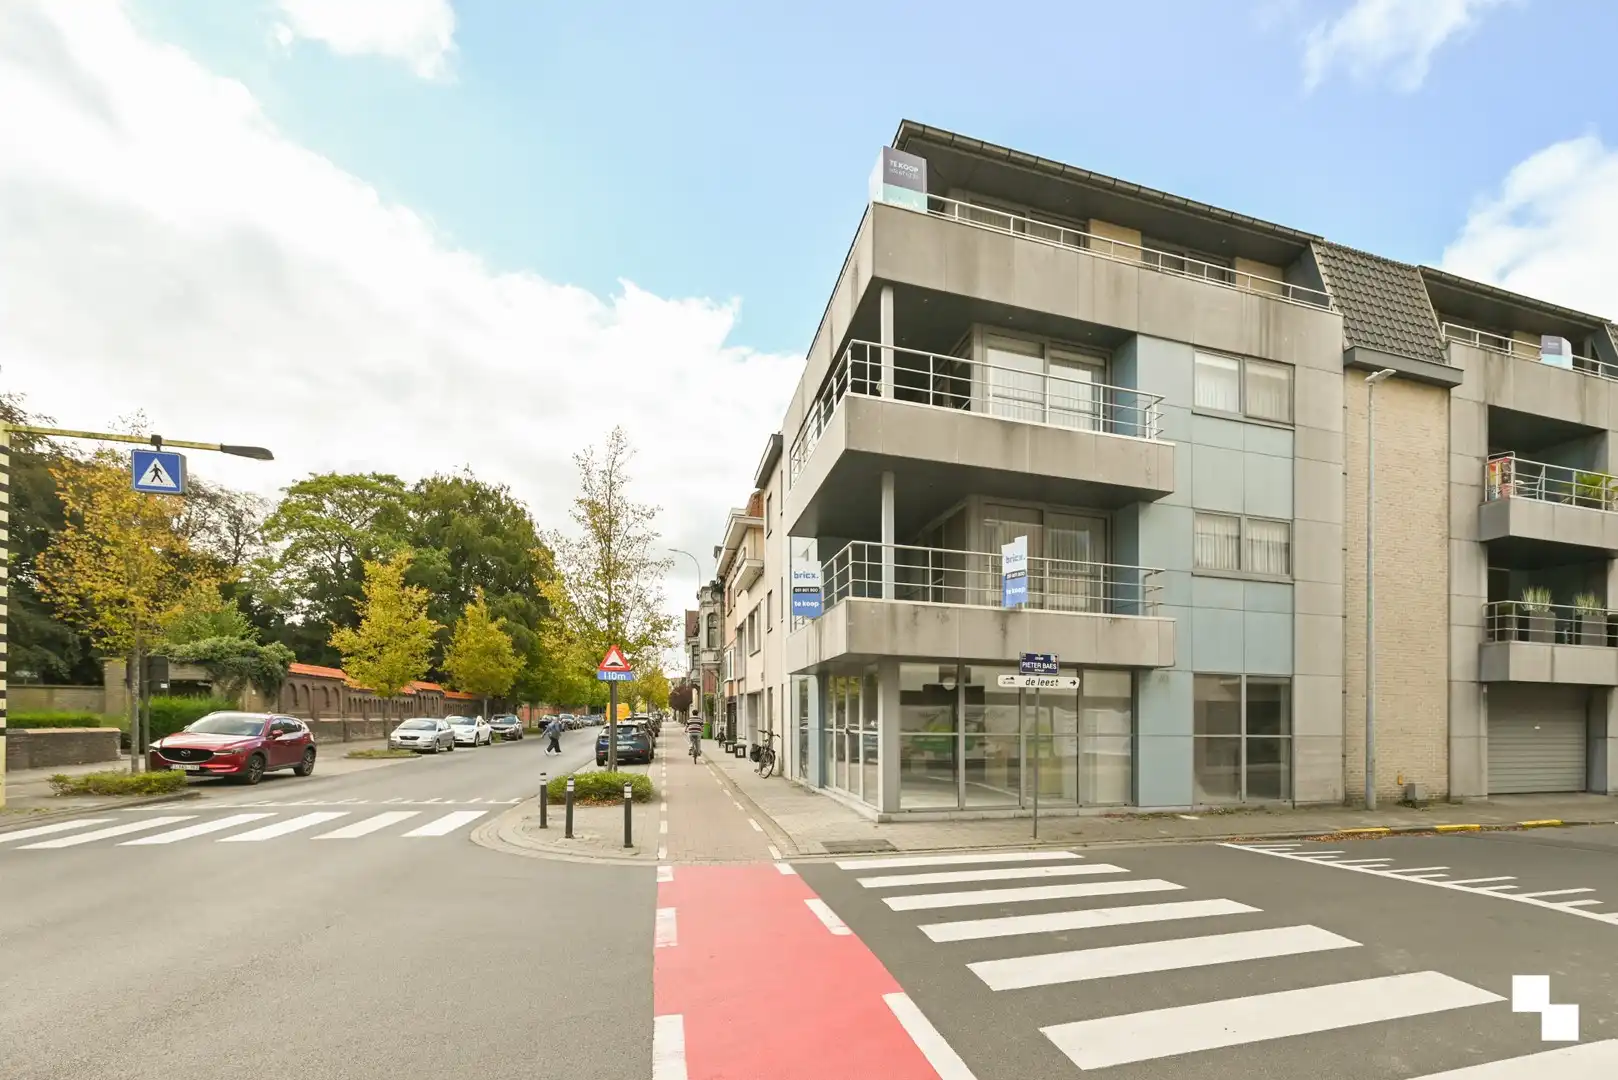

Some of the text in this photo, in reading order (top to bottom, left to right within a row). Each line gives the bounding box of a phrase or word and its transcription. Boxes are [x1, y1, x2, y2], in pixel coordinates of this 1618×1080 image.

[889, 159, 919, 172] TE KOOP
[793, 570, 819, 579] bricx.
[802, 600, 820, 608] koop
[1022, 661, 1042, 669] PIETER
[603, 671, 626, 680] 110m
[1025, 677, 1036, 686] de
[1037, 677, 1060, 687] leest
